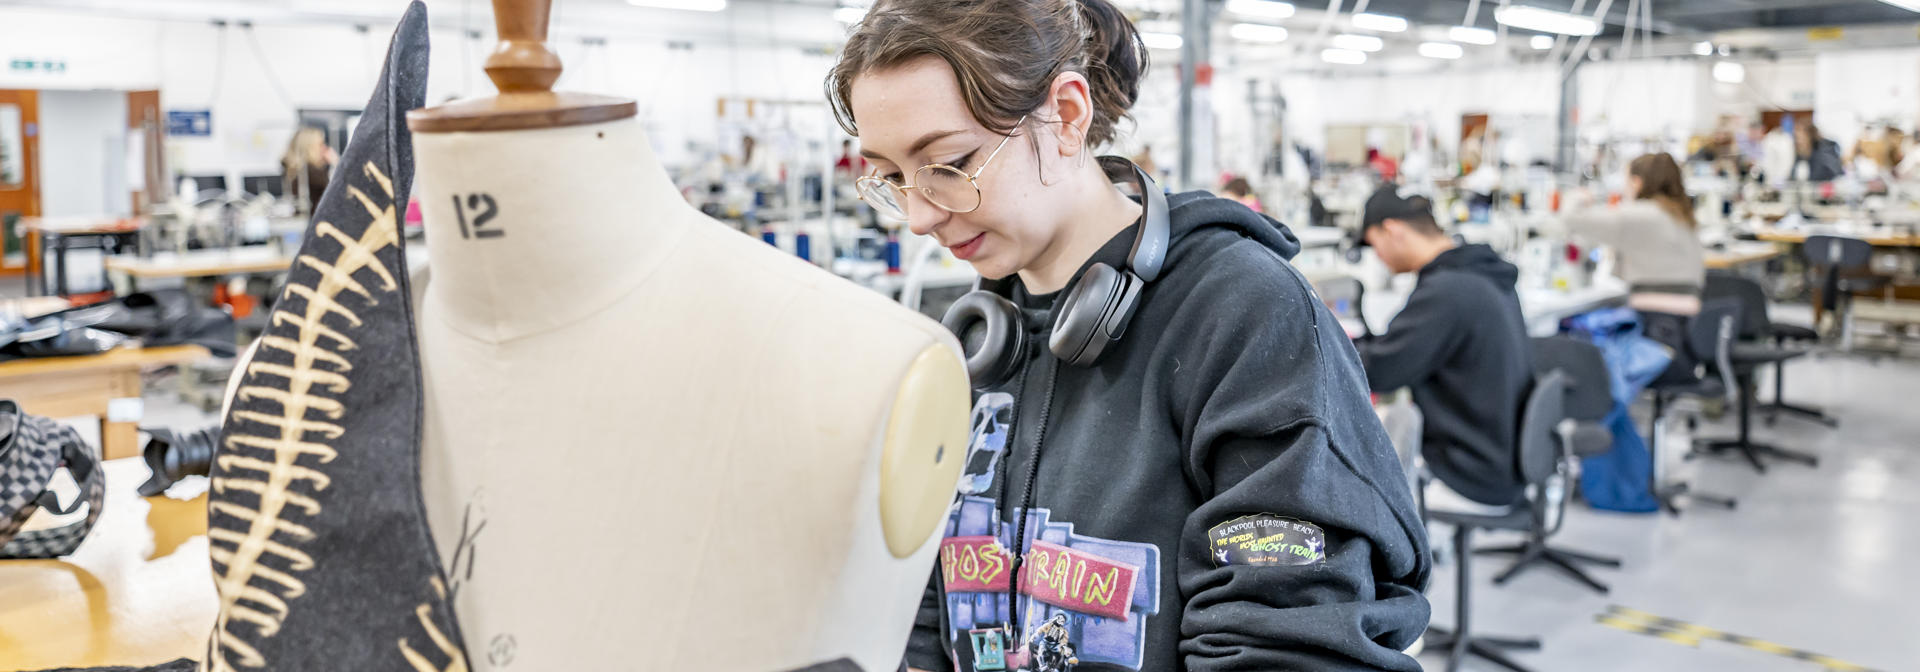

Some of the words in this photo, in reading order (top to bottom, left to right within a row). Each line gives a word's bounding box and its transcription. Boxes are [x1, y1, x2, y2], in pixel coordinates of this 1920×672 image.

[452, 193, 505, 239] 12
[1145, 236, 1159, 268] SONY
[1219, 520, 1257, 537] BLACKPOOL
[1256, 519, 1290, 529] PLEASURE
[1293, 523, 1315, 536] BEACH
[1216, 538, 1228, 547] THE
[1250, 542, 1289, 553] GHOST
[1289, 543, 1320, 561] TRAIN
[942, 543, 1004, 585] HOS
